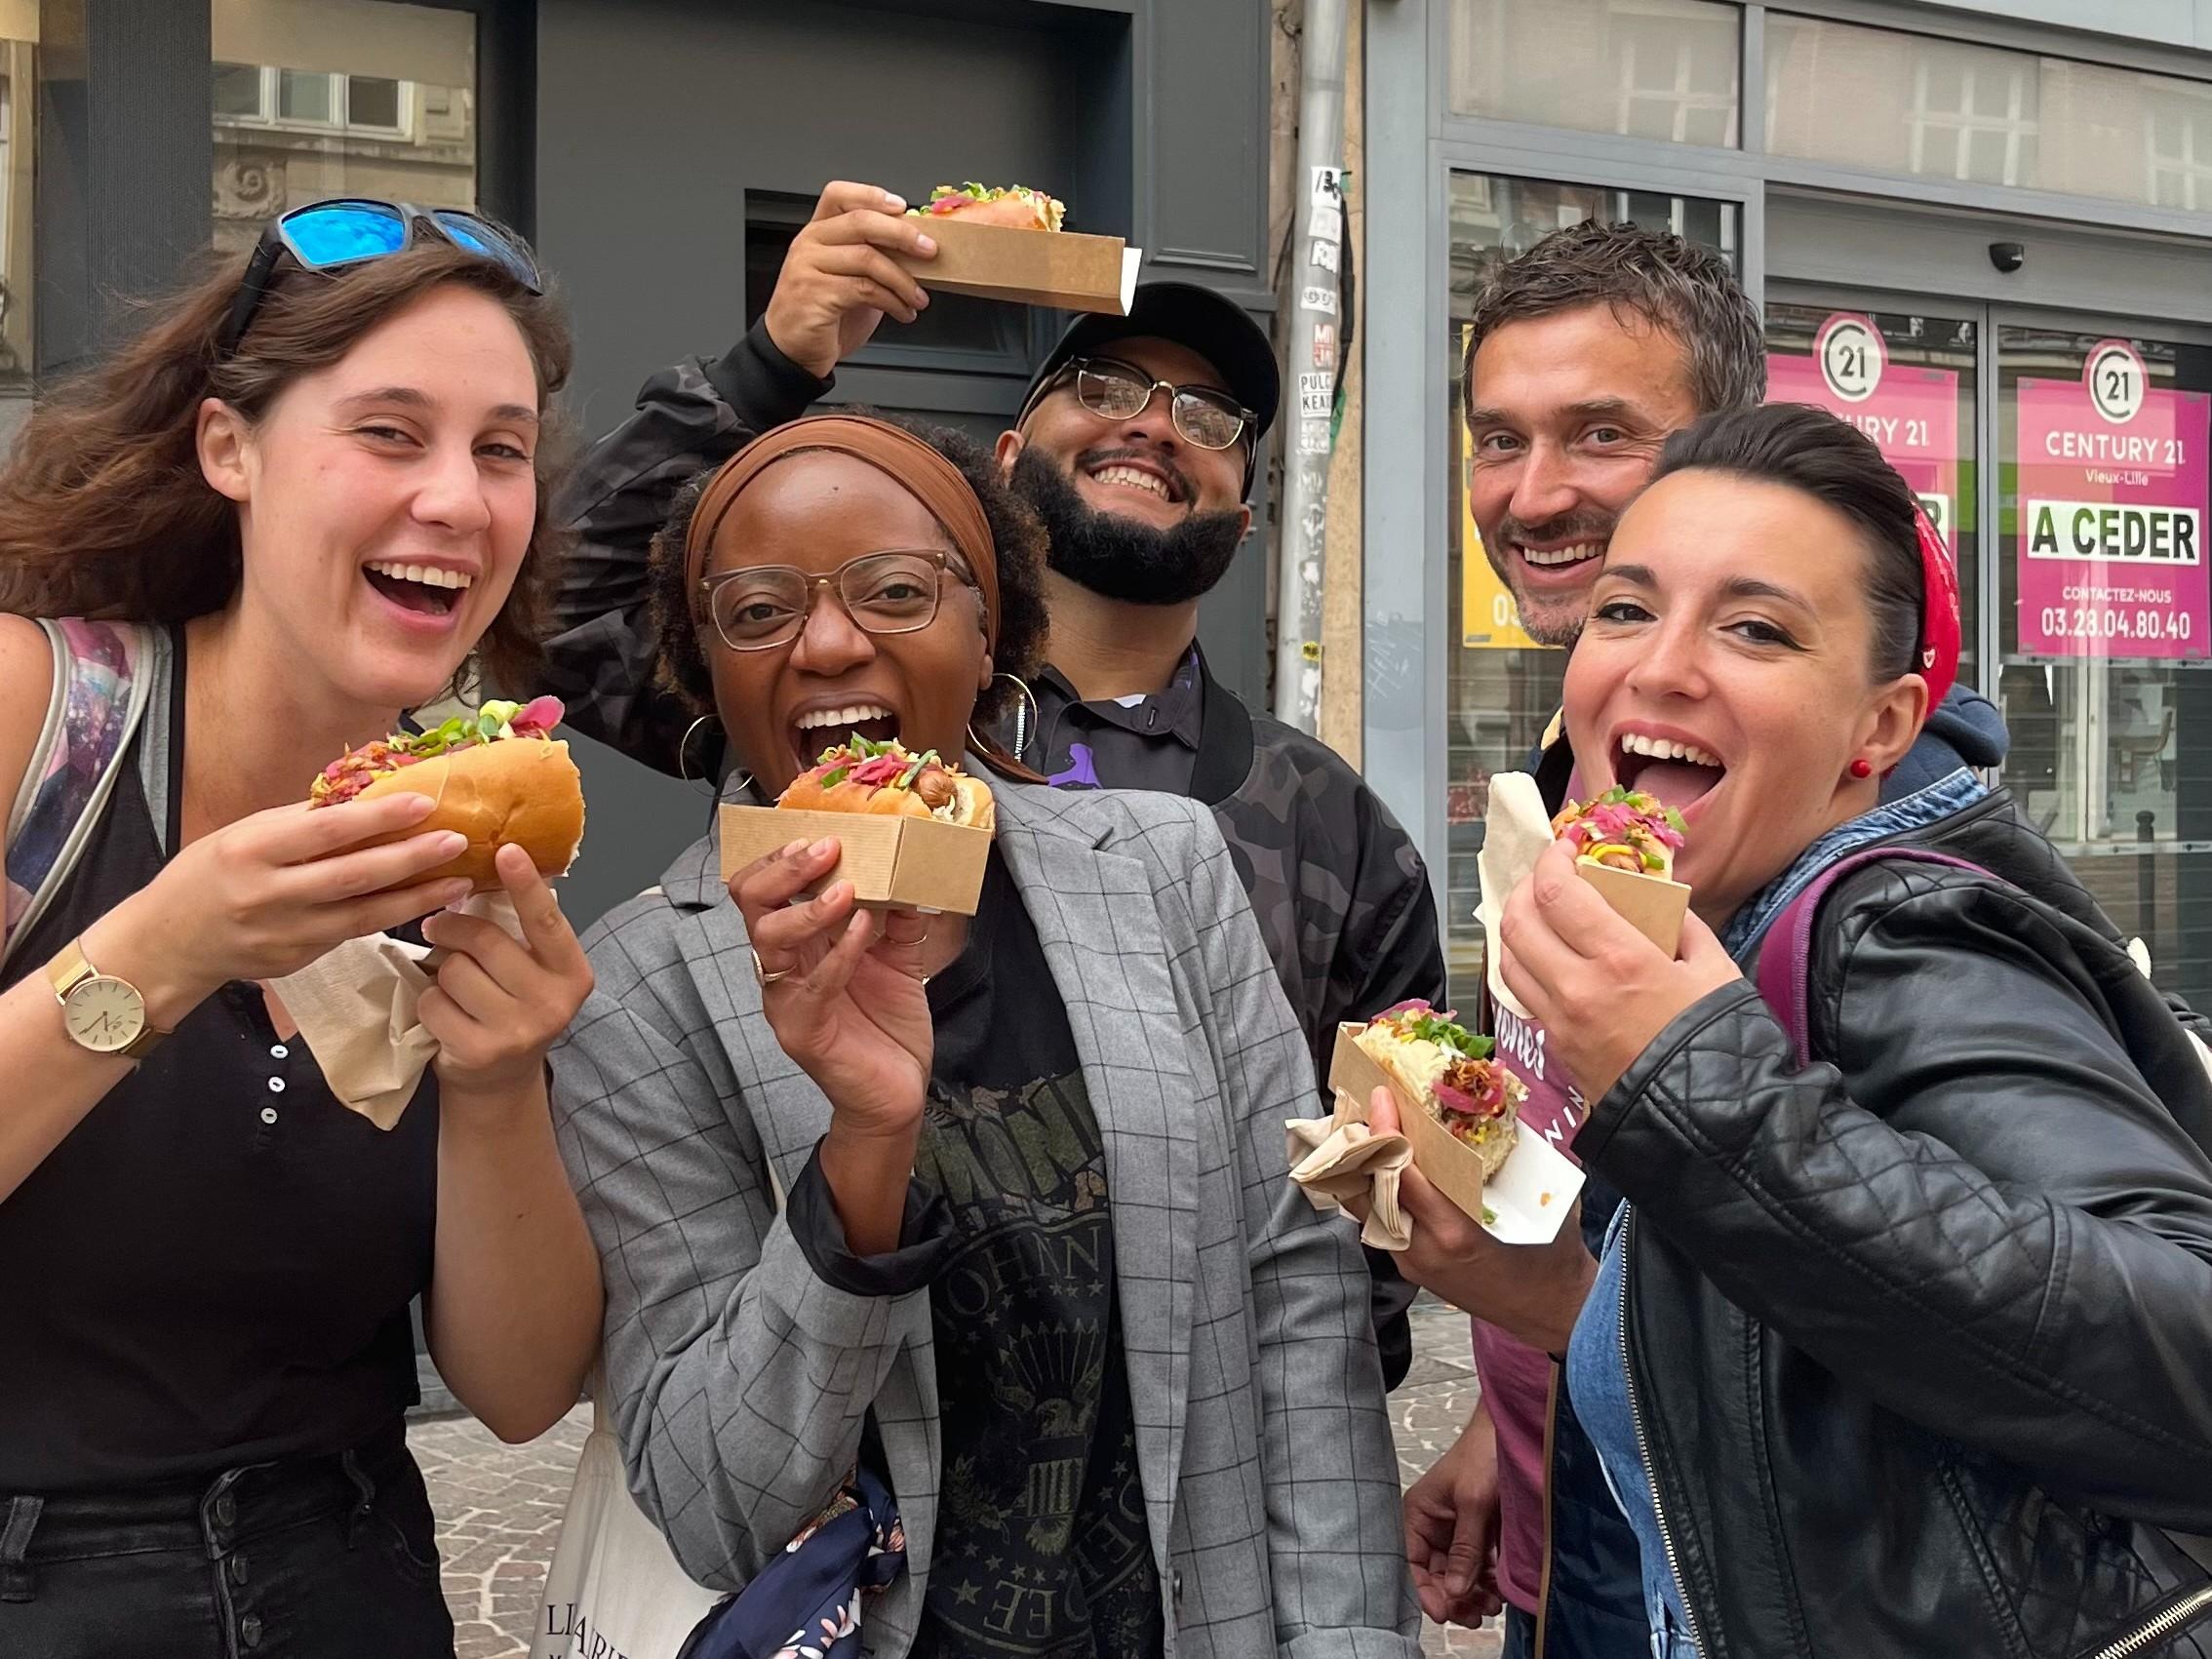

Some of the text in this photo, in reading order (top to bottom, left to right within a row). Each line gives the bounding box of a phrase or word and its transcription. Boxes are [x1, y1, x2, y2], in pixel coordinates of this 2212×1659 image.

[1838, 346, 1865, 377] 21
[2106, 372, 2129, 401] 21
[1906, 420, 1928, 446] 21
[2046, 431, 2184, 464] CENTURY 21
[2085, 468, 2149, 486] Vieux-Lille
[2032, 506, 2195, 560] A CEDER
[2062, 586, 2172, 604] CONTACTEZ-NOUS
[2041, 607, 2191, 640] 03.28.04.80.40
